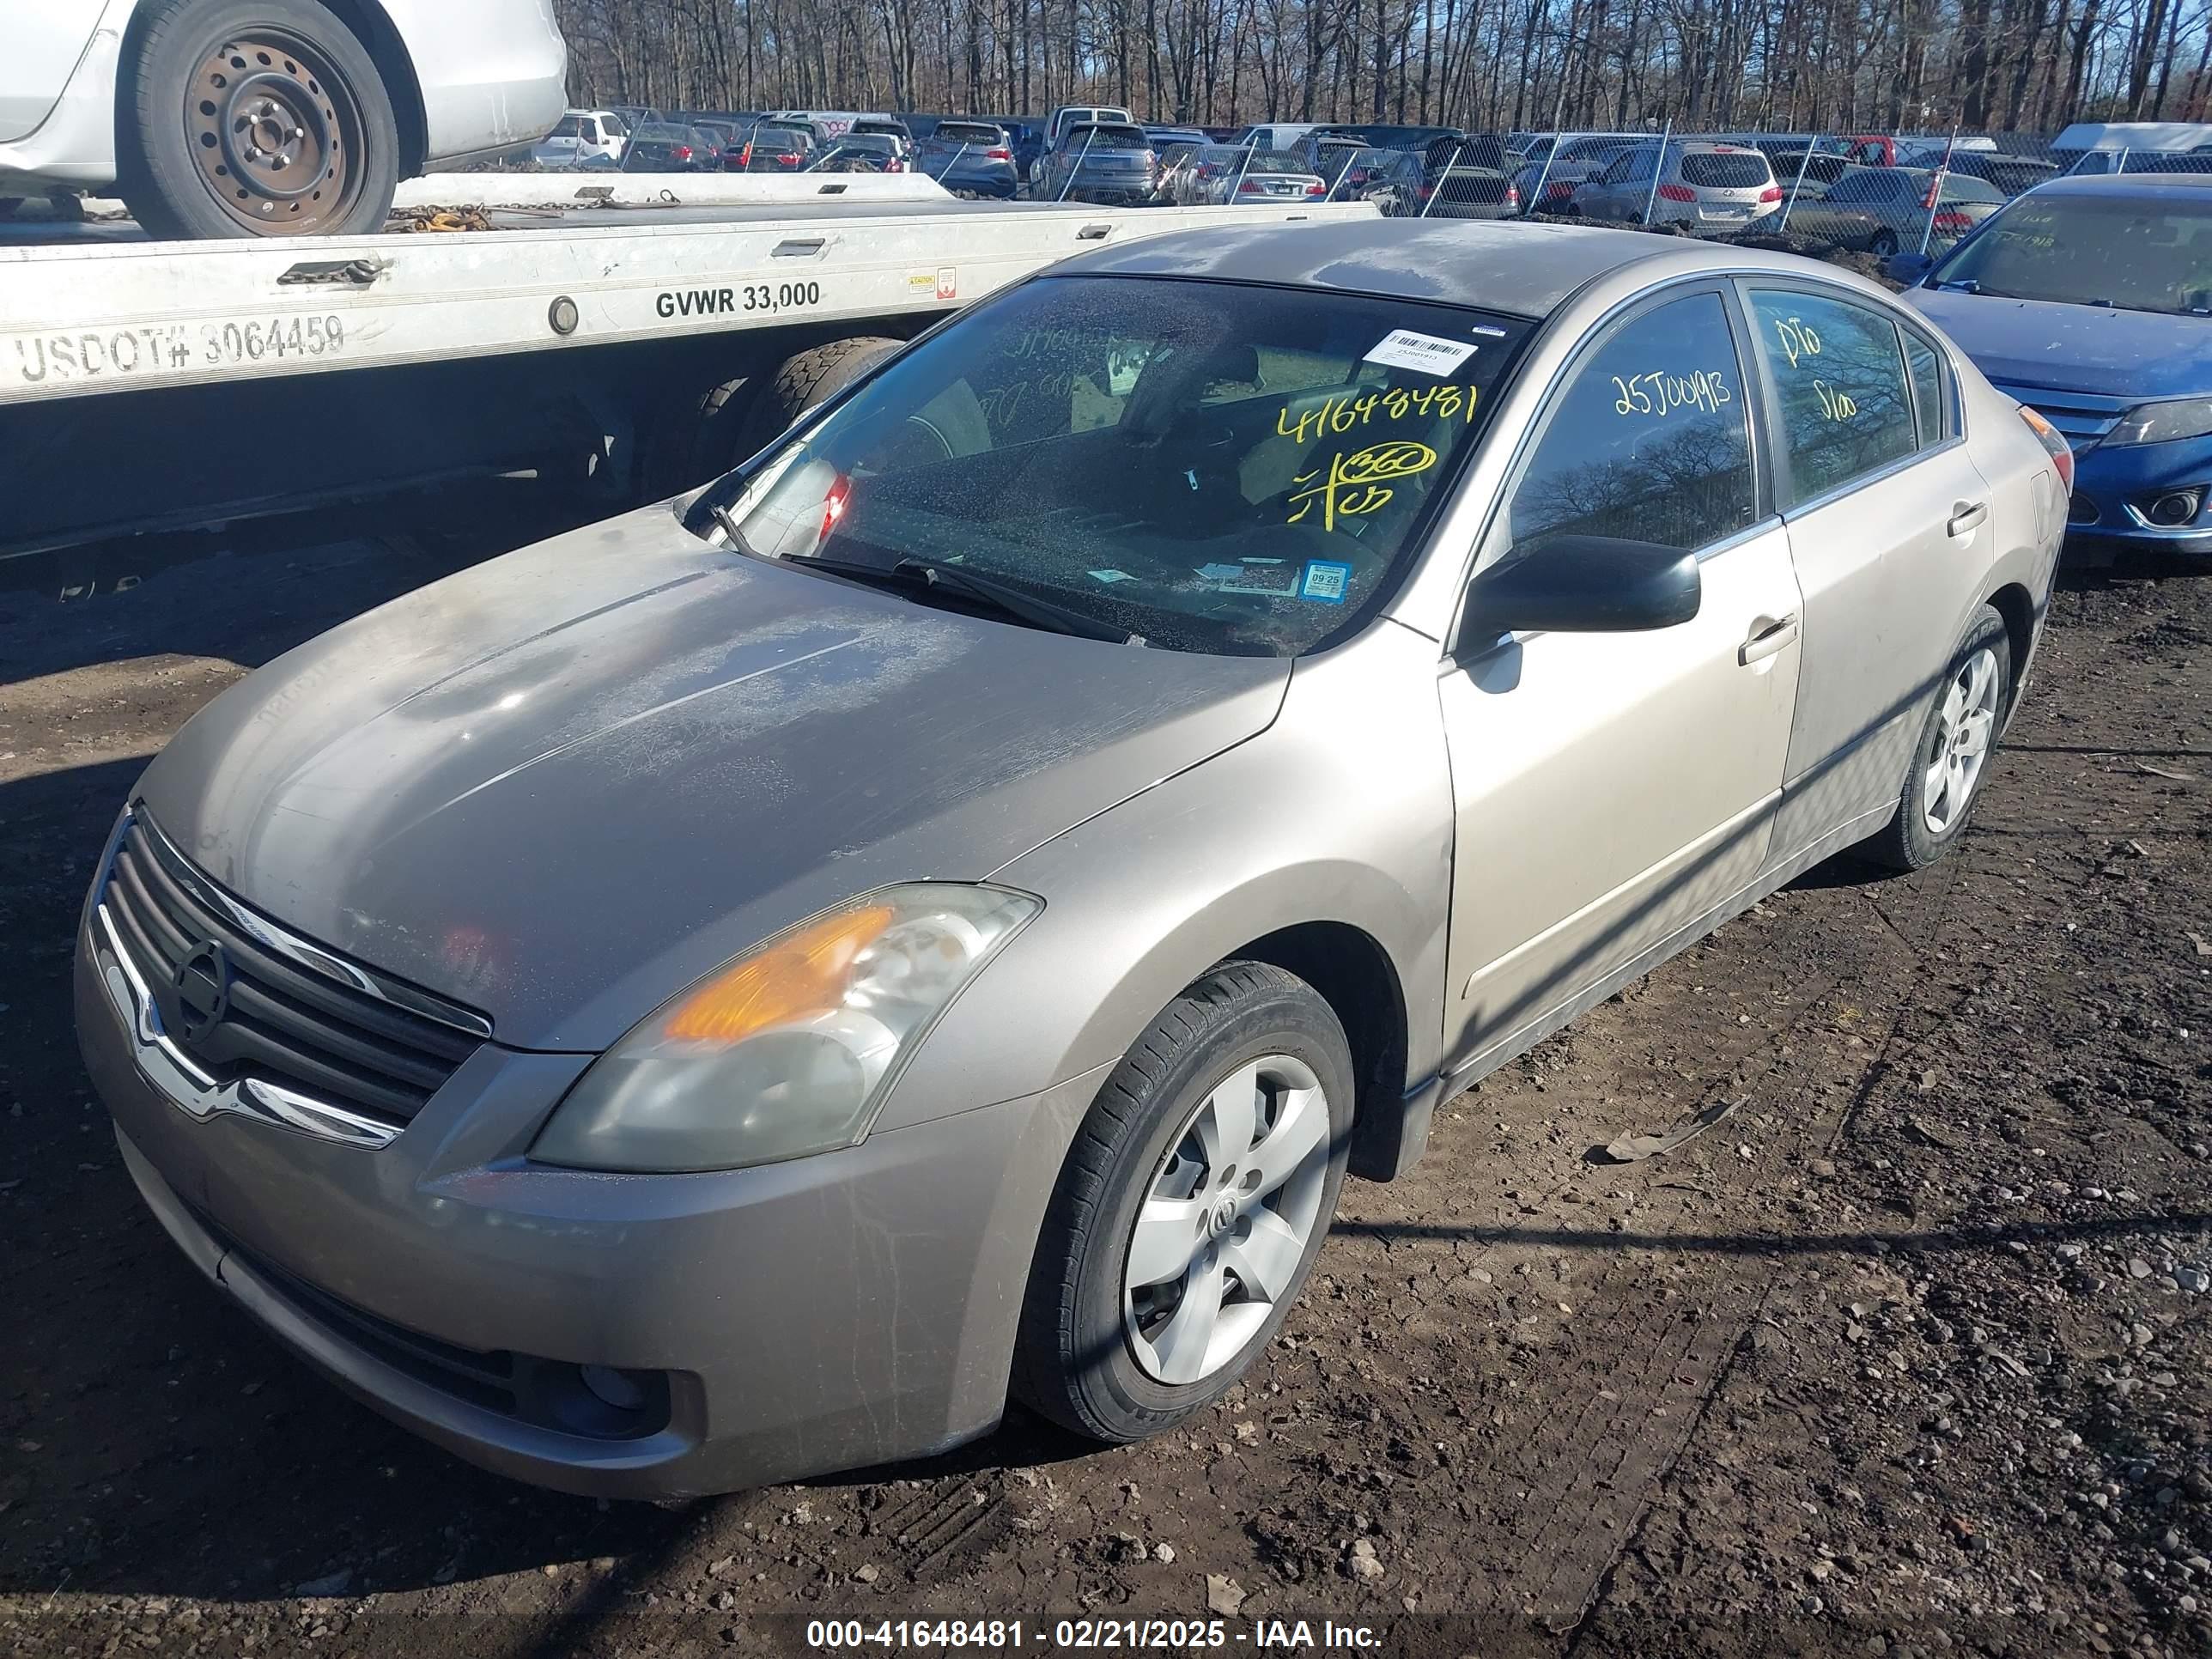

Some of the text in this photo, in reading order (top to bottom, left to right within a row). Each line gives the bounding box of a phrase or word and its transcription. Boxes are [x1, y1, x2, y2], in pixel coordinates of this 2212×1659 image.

[656, 282, 820, 318] GVWR 33,000
[15, 315, 344, 382] USDOT# 3064459
[1277, 386, 1476, 443] 41648481
